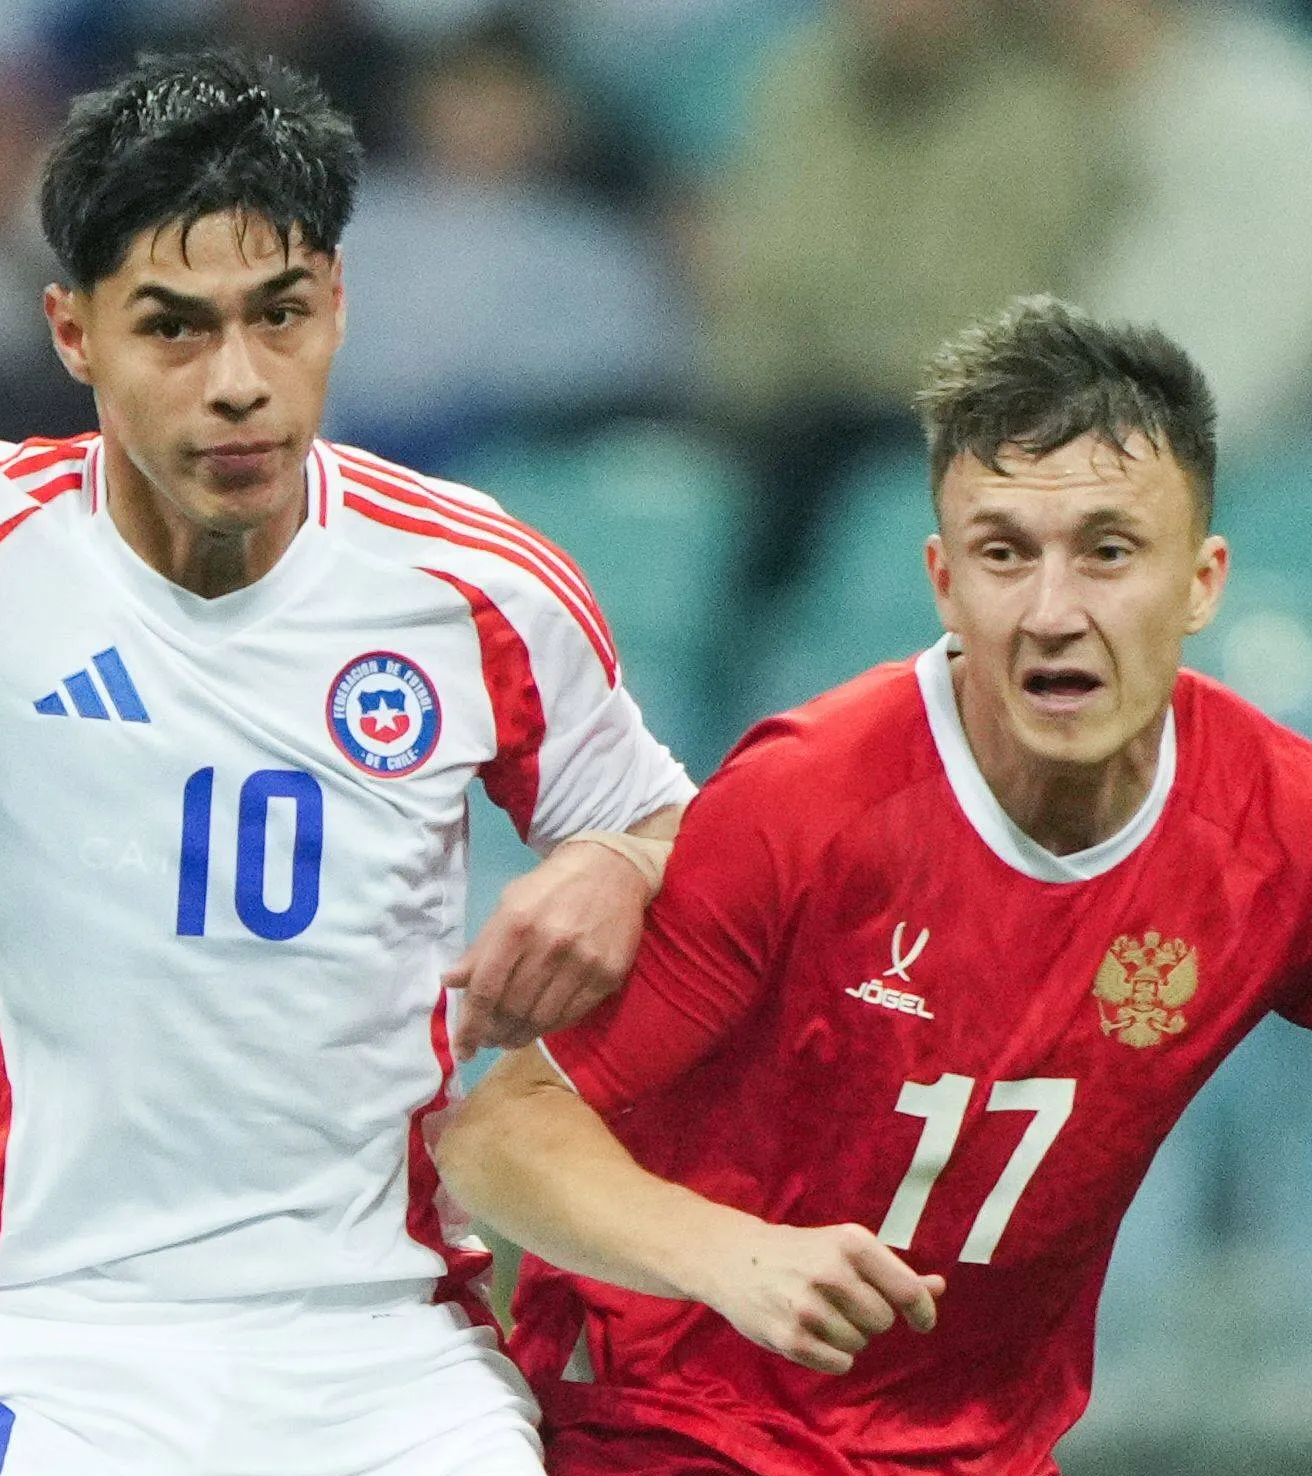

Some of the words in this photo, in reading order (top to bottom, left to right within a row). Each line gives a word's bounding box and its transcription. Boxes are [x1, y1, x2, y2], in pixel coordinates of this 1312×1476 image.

[386, 660, 402, 677] DE
[387, 749, 419, 771] CHILE
[176, 766, 324, 942] 10
[877, 1072, 1078, 1265] 17
